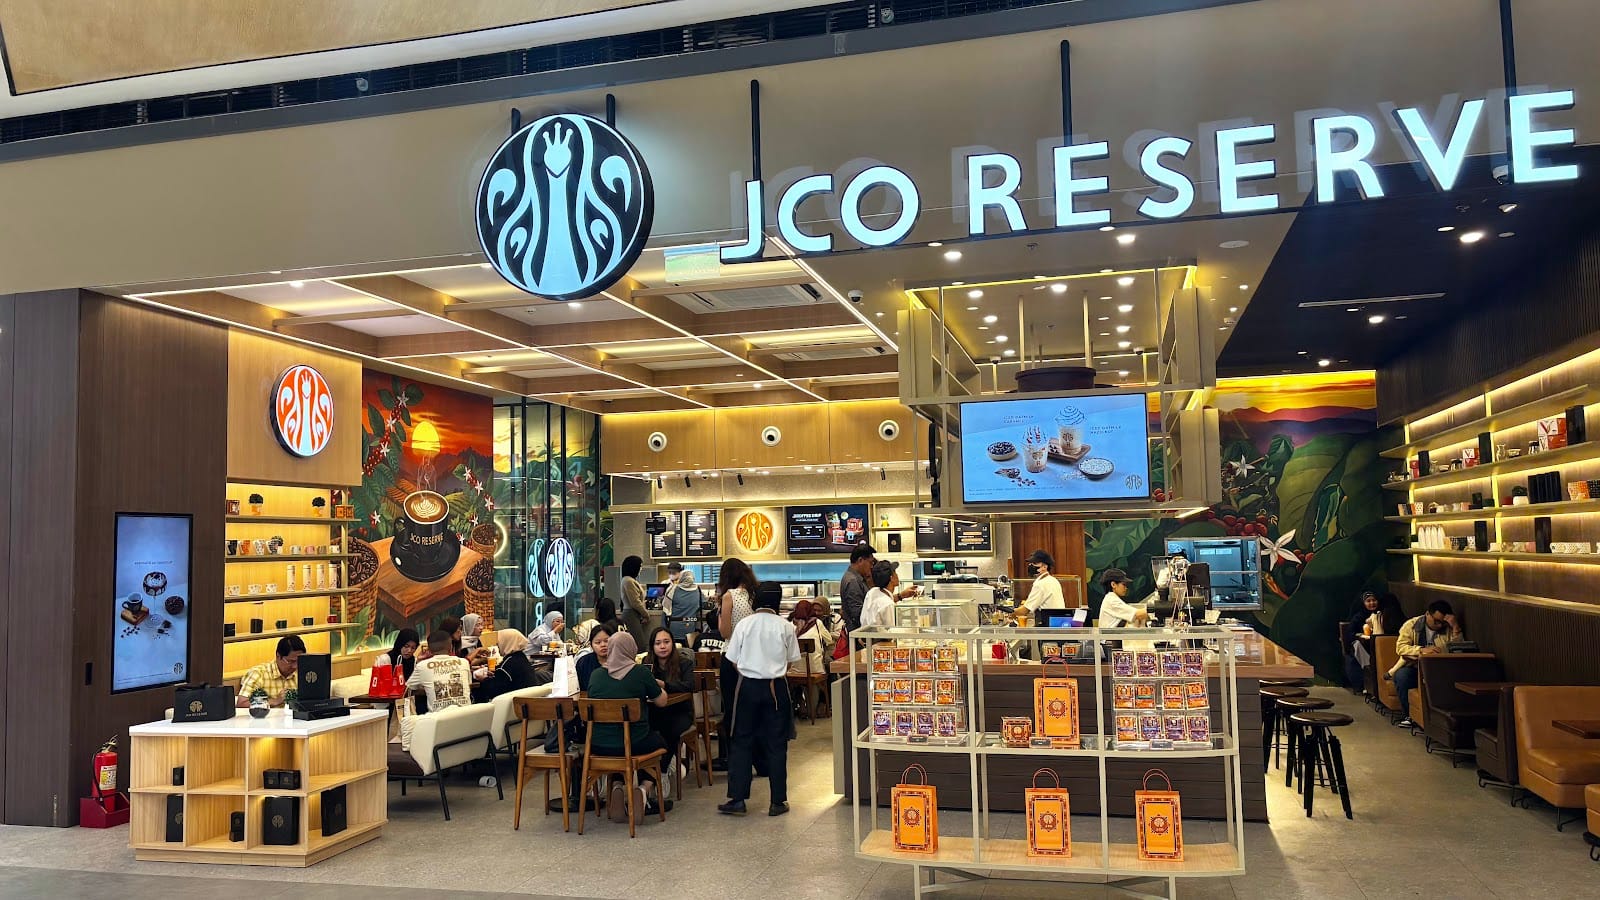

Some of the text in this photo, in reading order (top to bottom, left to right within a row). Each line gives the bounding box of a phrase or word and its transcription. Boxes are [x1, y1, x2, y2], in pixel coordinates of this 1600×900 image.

[720, 90, 1580, 260] JCO RESERVE
[421, 532, 443, 545] RESERVE
